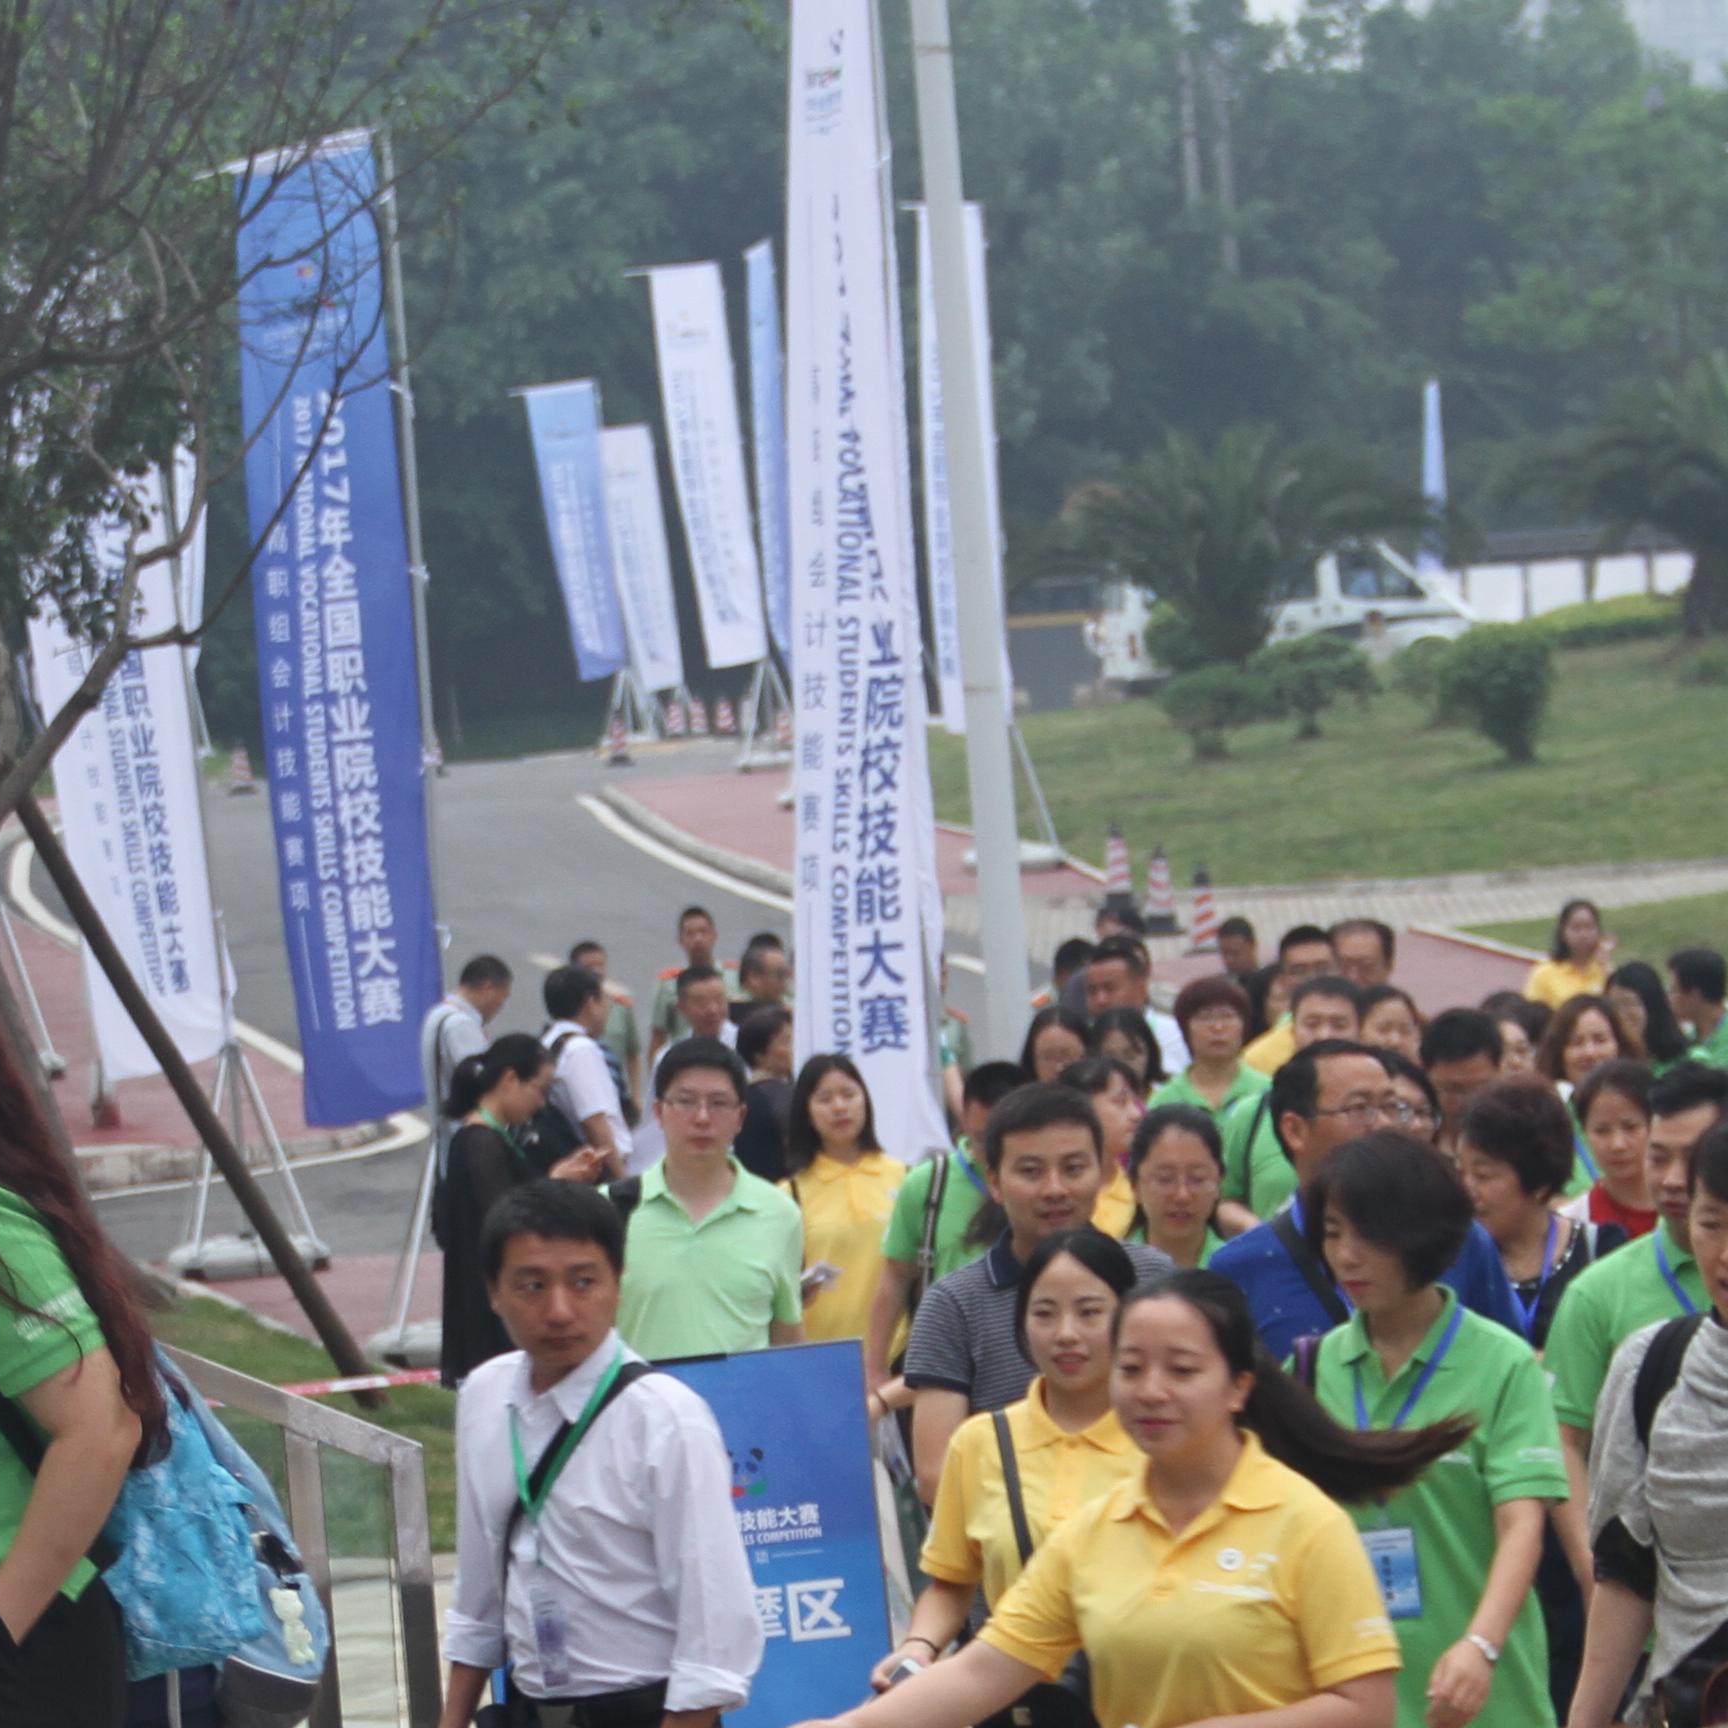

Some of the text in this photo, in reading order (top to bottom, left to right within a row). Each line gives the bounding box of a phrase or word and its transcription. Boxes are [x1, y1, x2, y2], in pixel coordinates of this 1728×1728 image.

[298, 561, 324, 699] VOCATIONAL
[835, 616, 861, 756] STUDENTS
[305, 703, 333, 809] STUDENTS
[121, 819, 147, 874] SKILLS
[313, 814, 340, 881] SKILLS
[829, 768, 854, 856] SKILLS
[320, 885, 357, 1031] COMPETITION
[757, 1526, 823, 1544] COMPETITION
